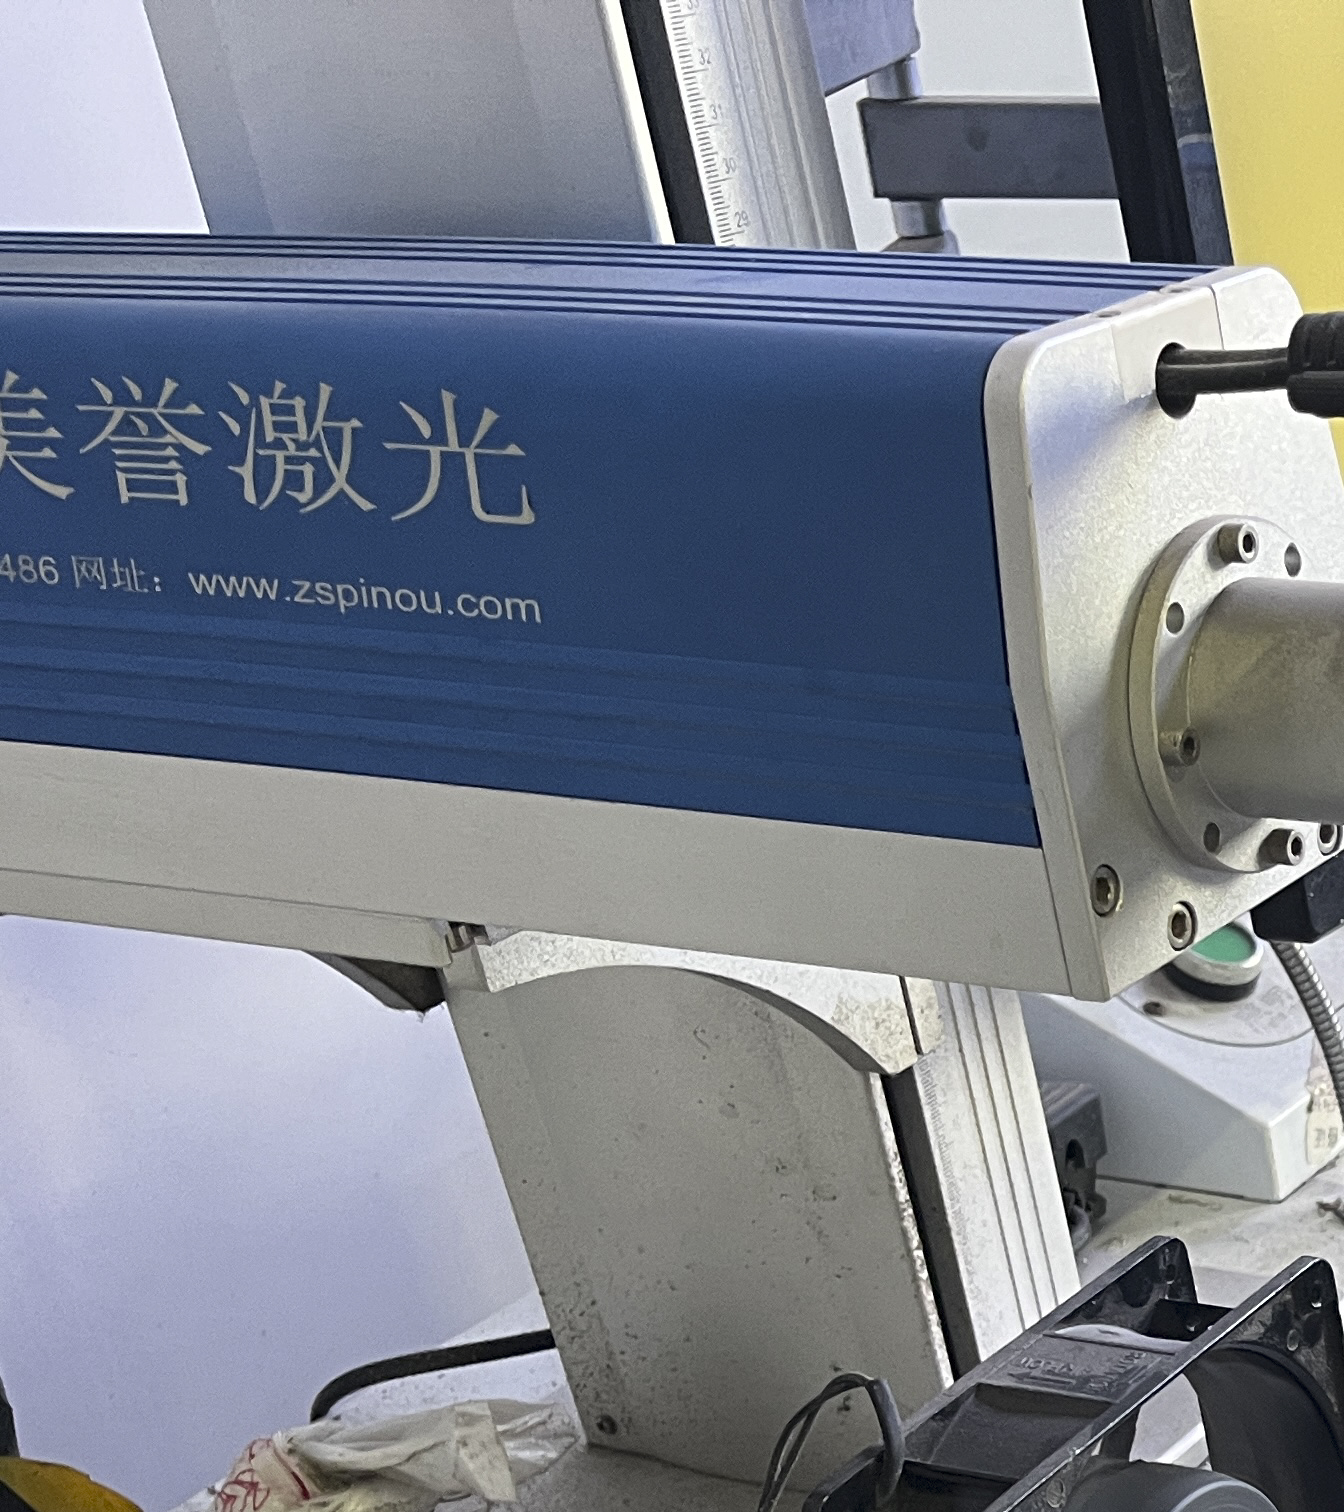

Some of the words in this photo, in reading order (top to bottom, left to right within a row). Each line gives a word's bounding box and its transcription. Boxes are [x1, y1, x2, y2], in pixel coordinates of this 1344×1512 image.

[698, 47, 713, 66] 32
[722, 156, 737, 175] 30
[734, 210, 750, 229] 29
[0, 369, 536, 526] 美誉激光
[0, 553, 60, 585] 486
[188, 571, 543, 624] www.zspinou.com
